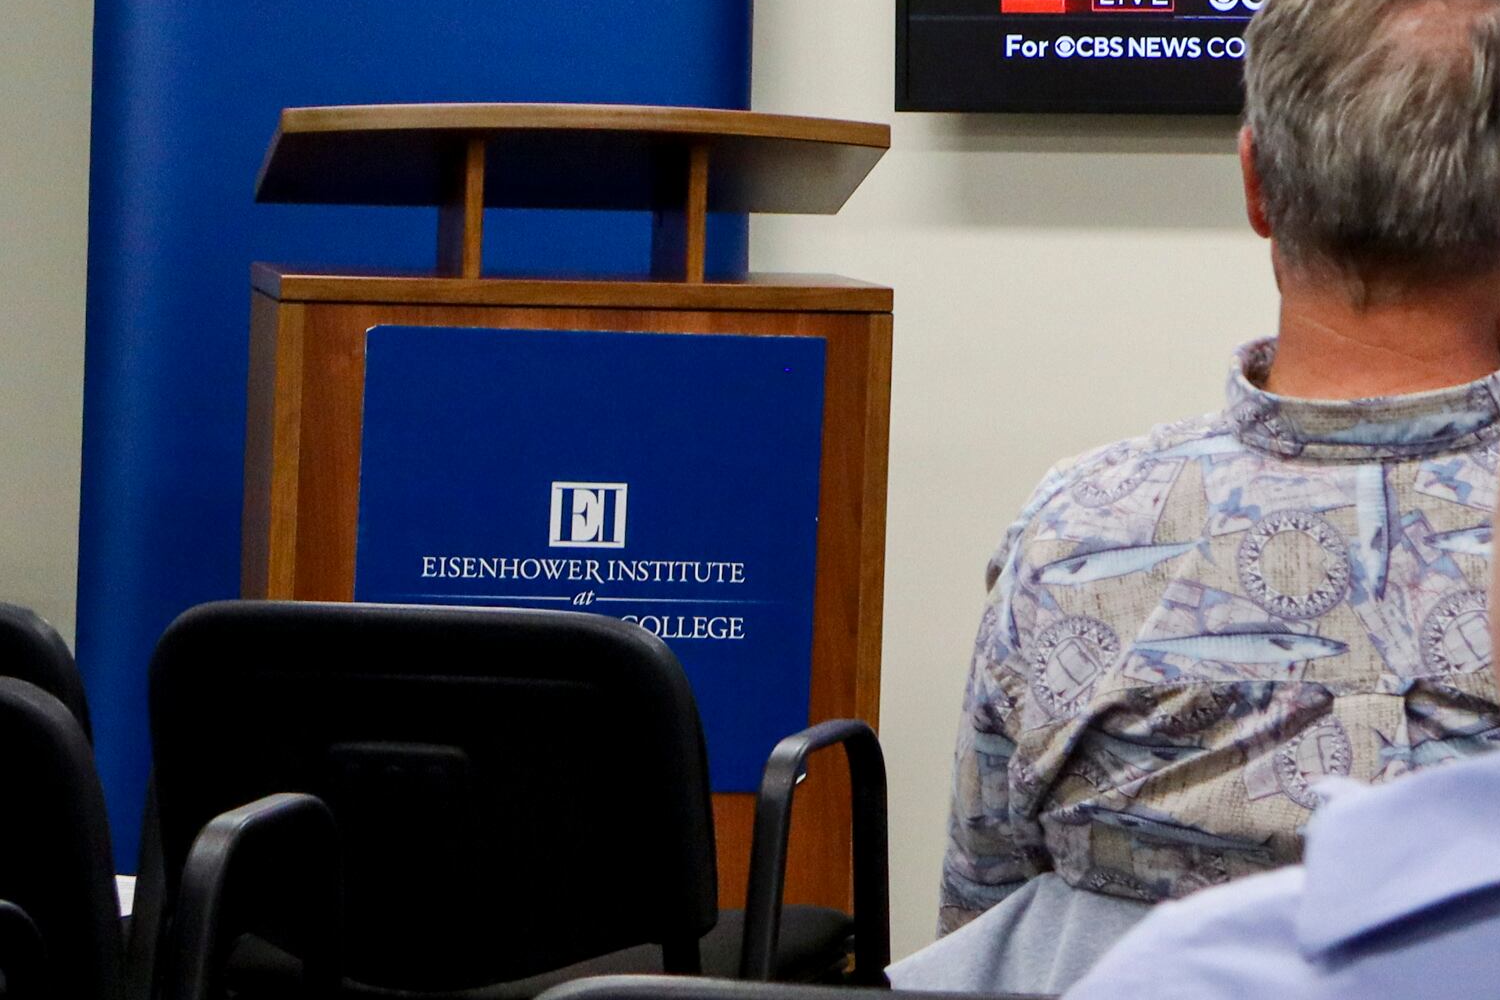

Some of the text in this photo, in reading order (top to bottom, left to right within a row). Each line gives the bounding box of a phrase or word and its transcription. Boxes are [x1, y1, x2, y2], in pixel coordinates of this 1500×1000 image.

[1006, 35, 1049, 57] For
[1076, 37, 1124, 57] CBS
[1128, 37, 1202, 58] NEWS
[1206, 37, 1246, 58] CO
[422, 556, 745, 584] EISENHOWER INSTITUTE
[573, 590, 595, 606] at
